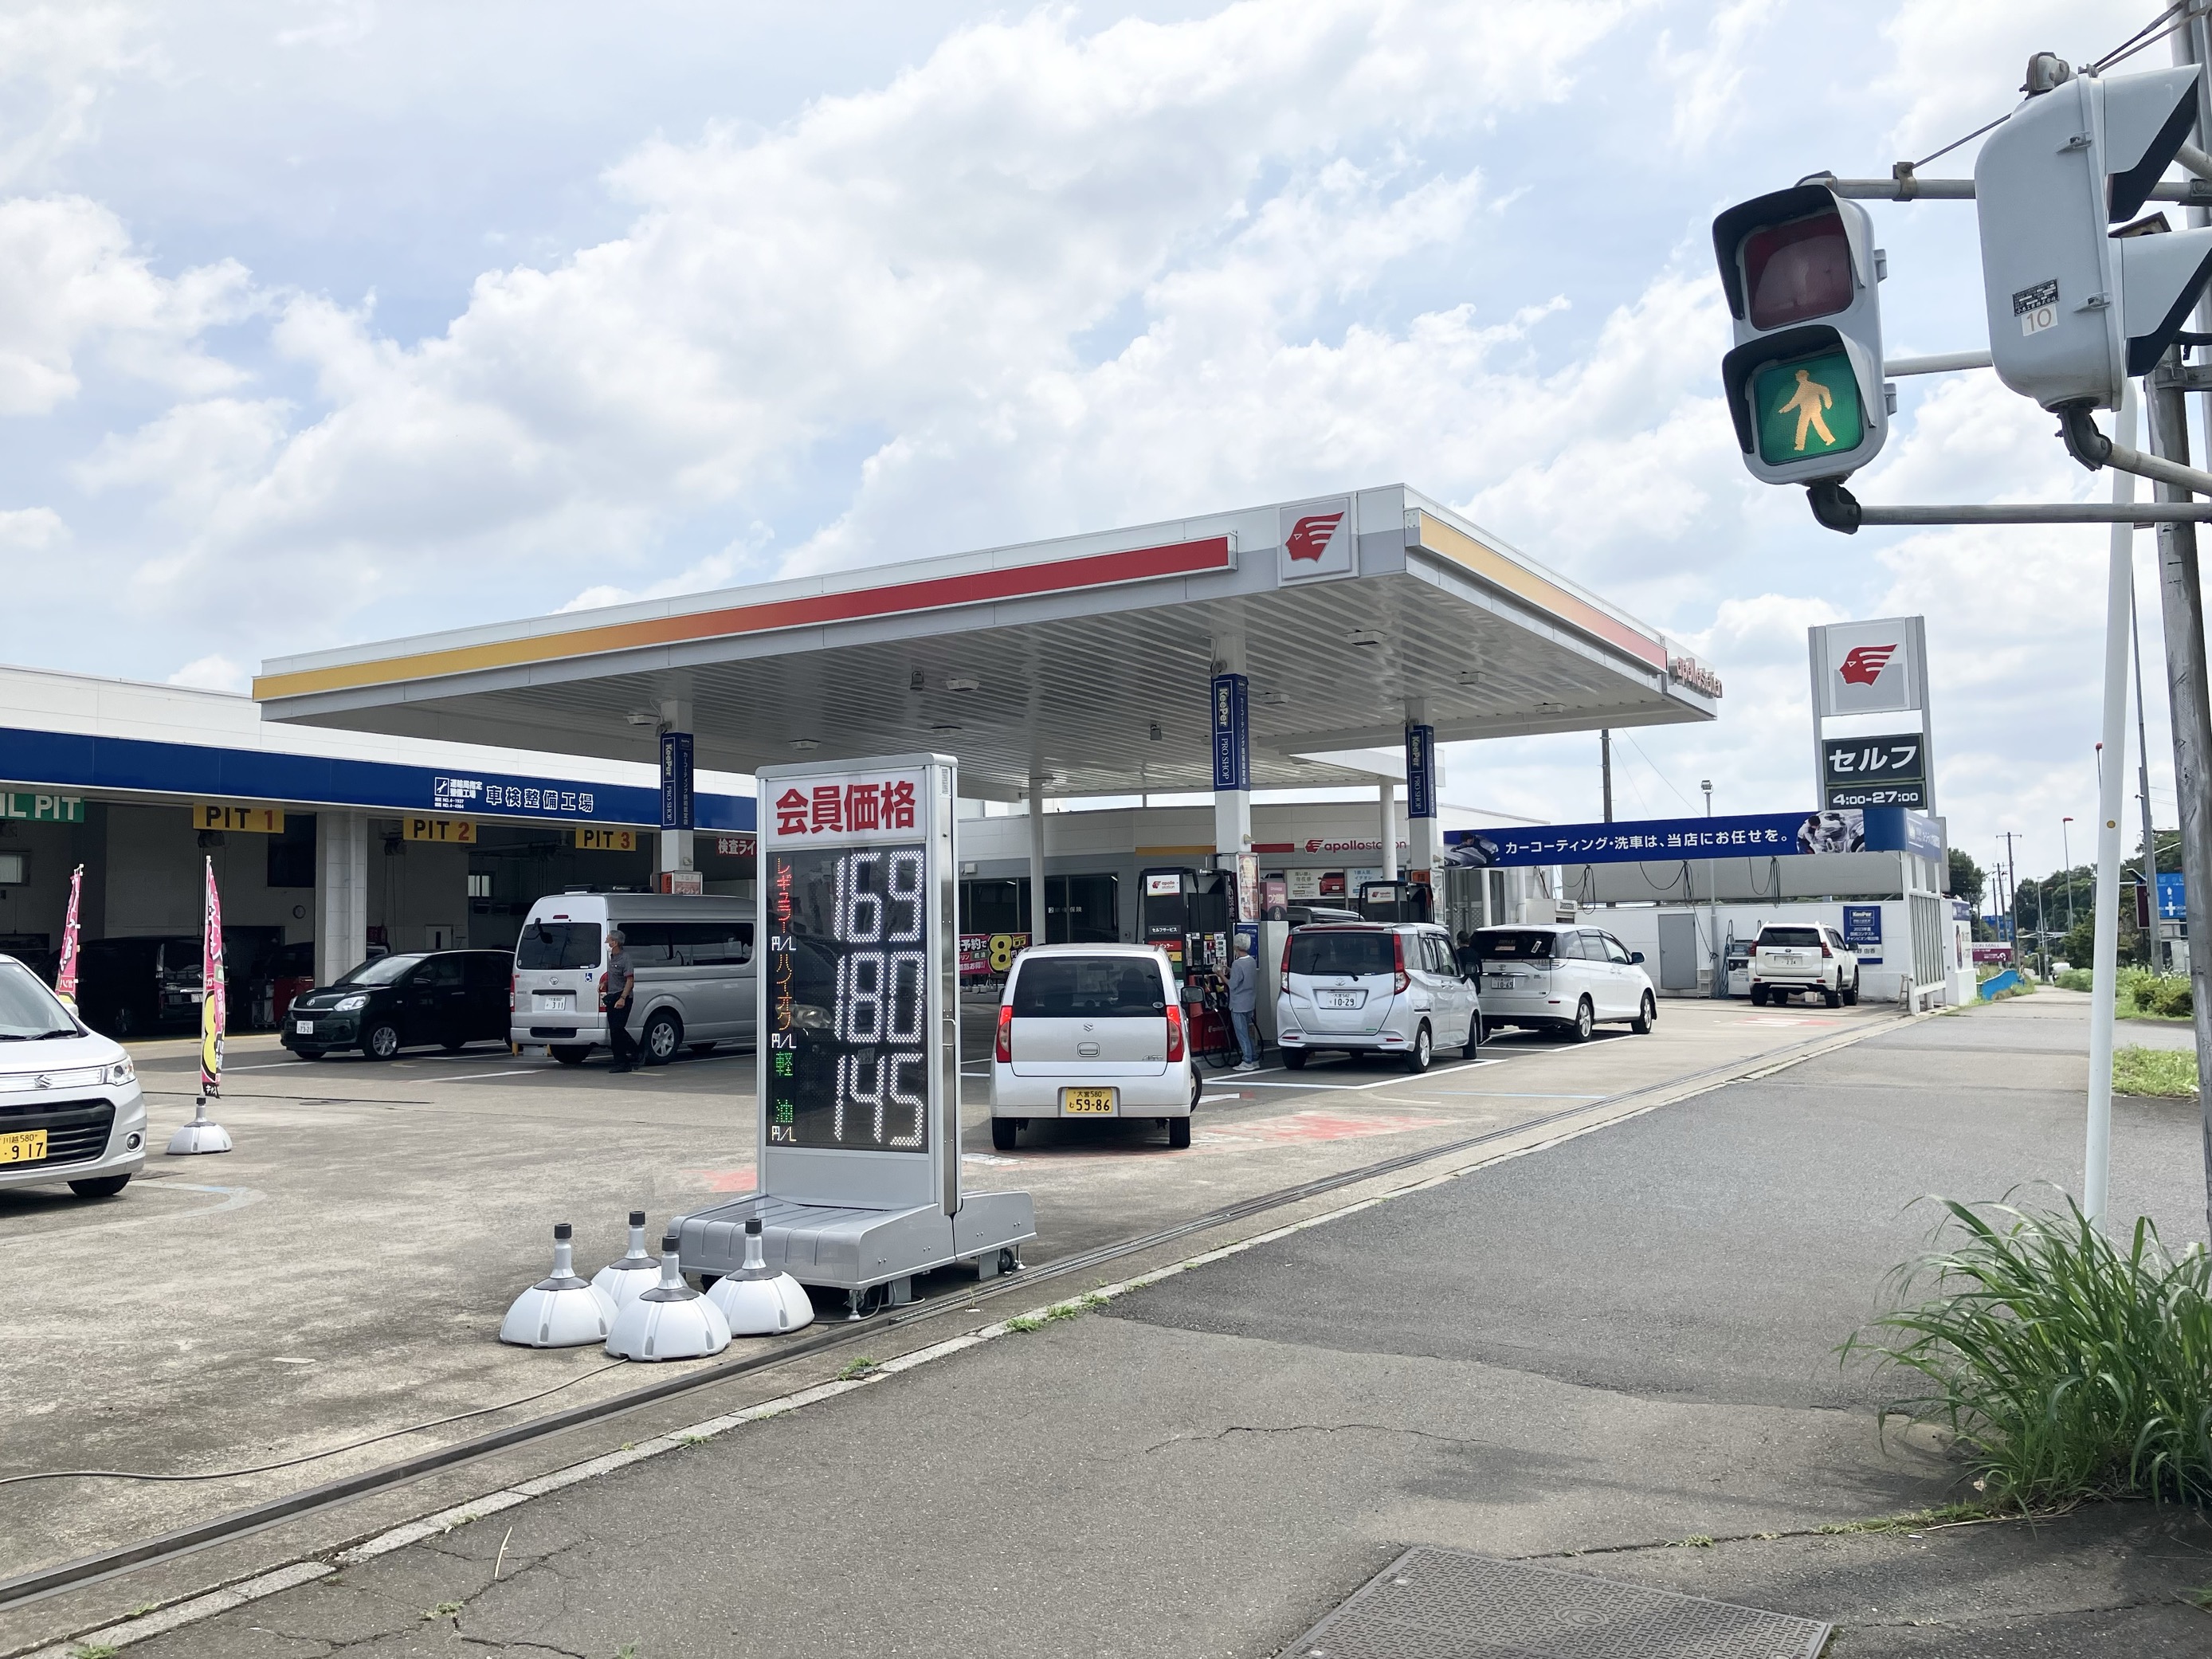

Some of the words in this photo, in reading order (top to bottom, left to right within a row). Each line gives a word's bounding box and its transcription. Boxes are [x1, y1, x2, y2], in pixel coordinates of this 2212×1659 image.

[2026, 308, 2052, 331] 10
[1829, 746, 1917, 772] セルフ
[0, 792, 26, 818] IL
[35, 795, 80, 820] PIT
[486, 786, 594, 813] 車検整備工場
[776, 781, 916, 835] 会員価格
[1833, 791, 1919, 805] 4:00-27:00
[206, 805, 251, 829] PIT
[265, 810, 273, 830] 1
[414, 819, 450, 839] PIT
[458, 822, 469, 841] 2
[584, 829, 614, 848] PIT
[620, 832, 630, 849] 3
[718, 837, 757, 856] 検査ライ
[1505, 830, 1787, 854] カーコーティング・洗車は、当店にお任せを。
[777, 857, 792, 934] レギュラー
[833, 850, 924, 943] 169
[989, 935, 1013, 971] 8
[776, 954, 793, 1030] ハイオク
[834, 951, 925, 1043] 180
[834, 1053, 924, 1147] 145
[1076, 1099, 1110, 1111] 59-86
[3, 1134, 34, 1144] 川越580
